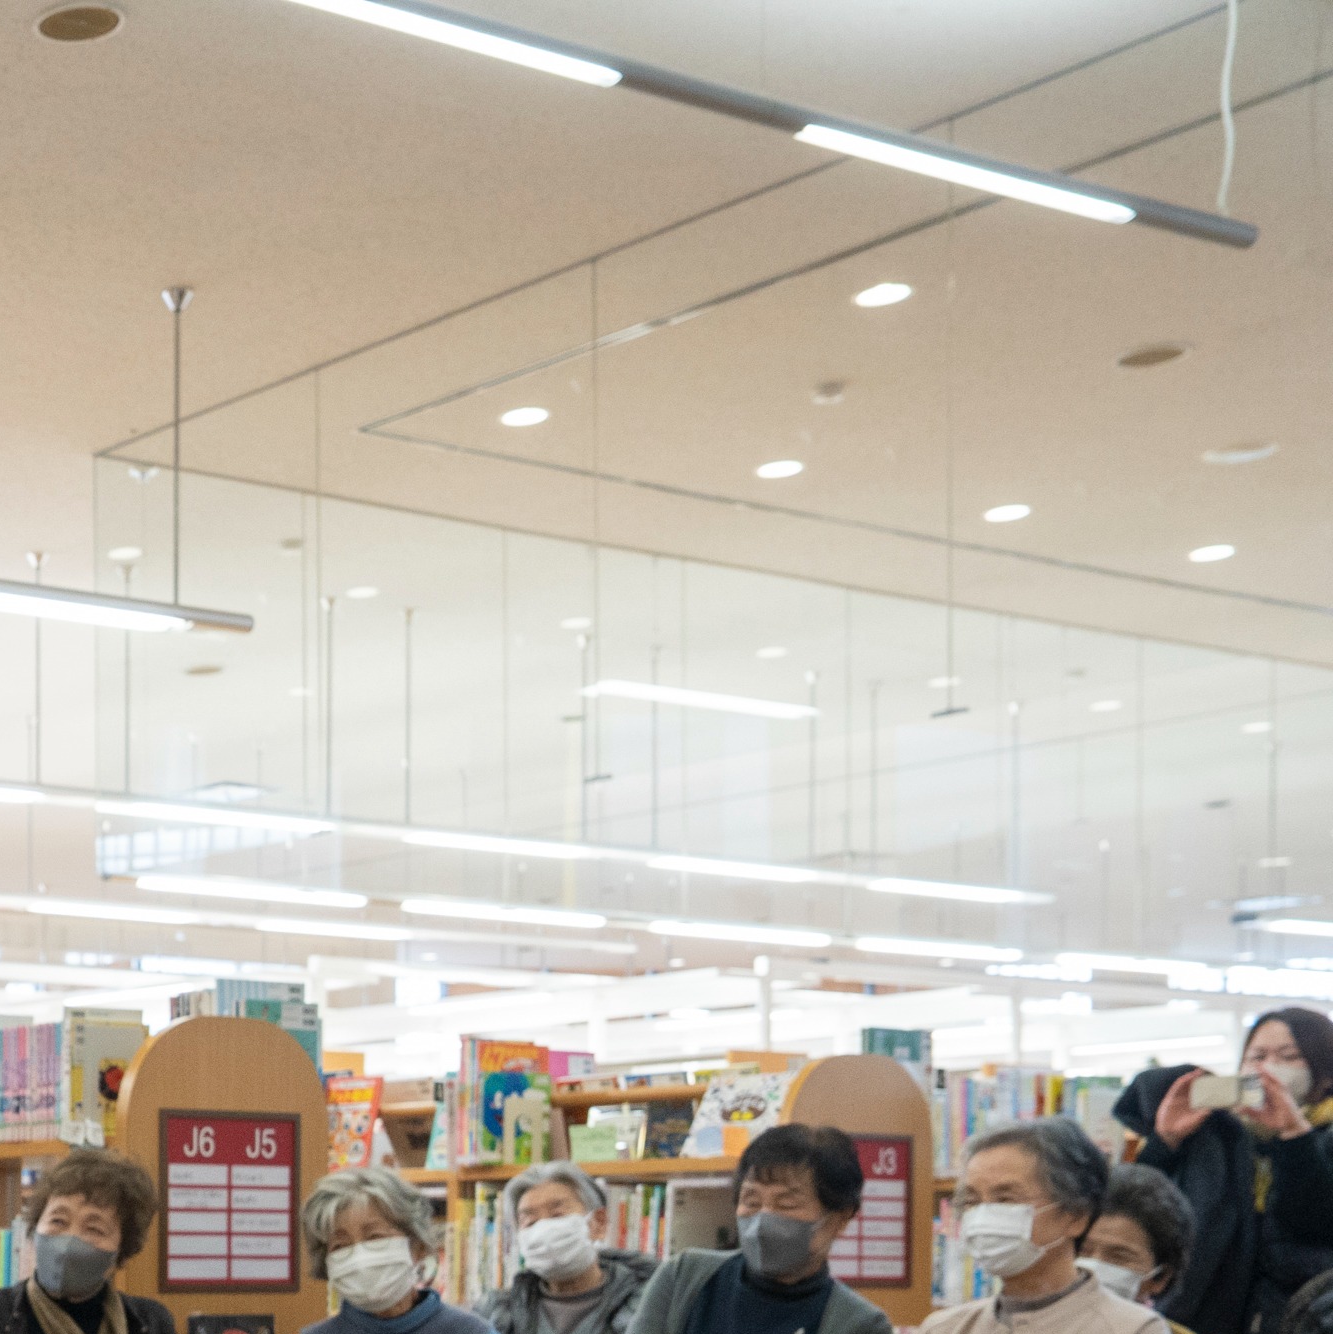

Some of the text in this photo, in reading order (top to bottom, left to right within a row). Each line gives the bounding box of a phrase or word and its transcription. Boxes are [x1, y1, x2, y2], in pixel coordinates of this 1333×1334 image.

[183, 1126, 216, 1158] J6
[245, 1128, 278, 1160] J5
[871, 1146, 898, 1175] J3
